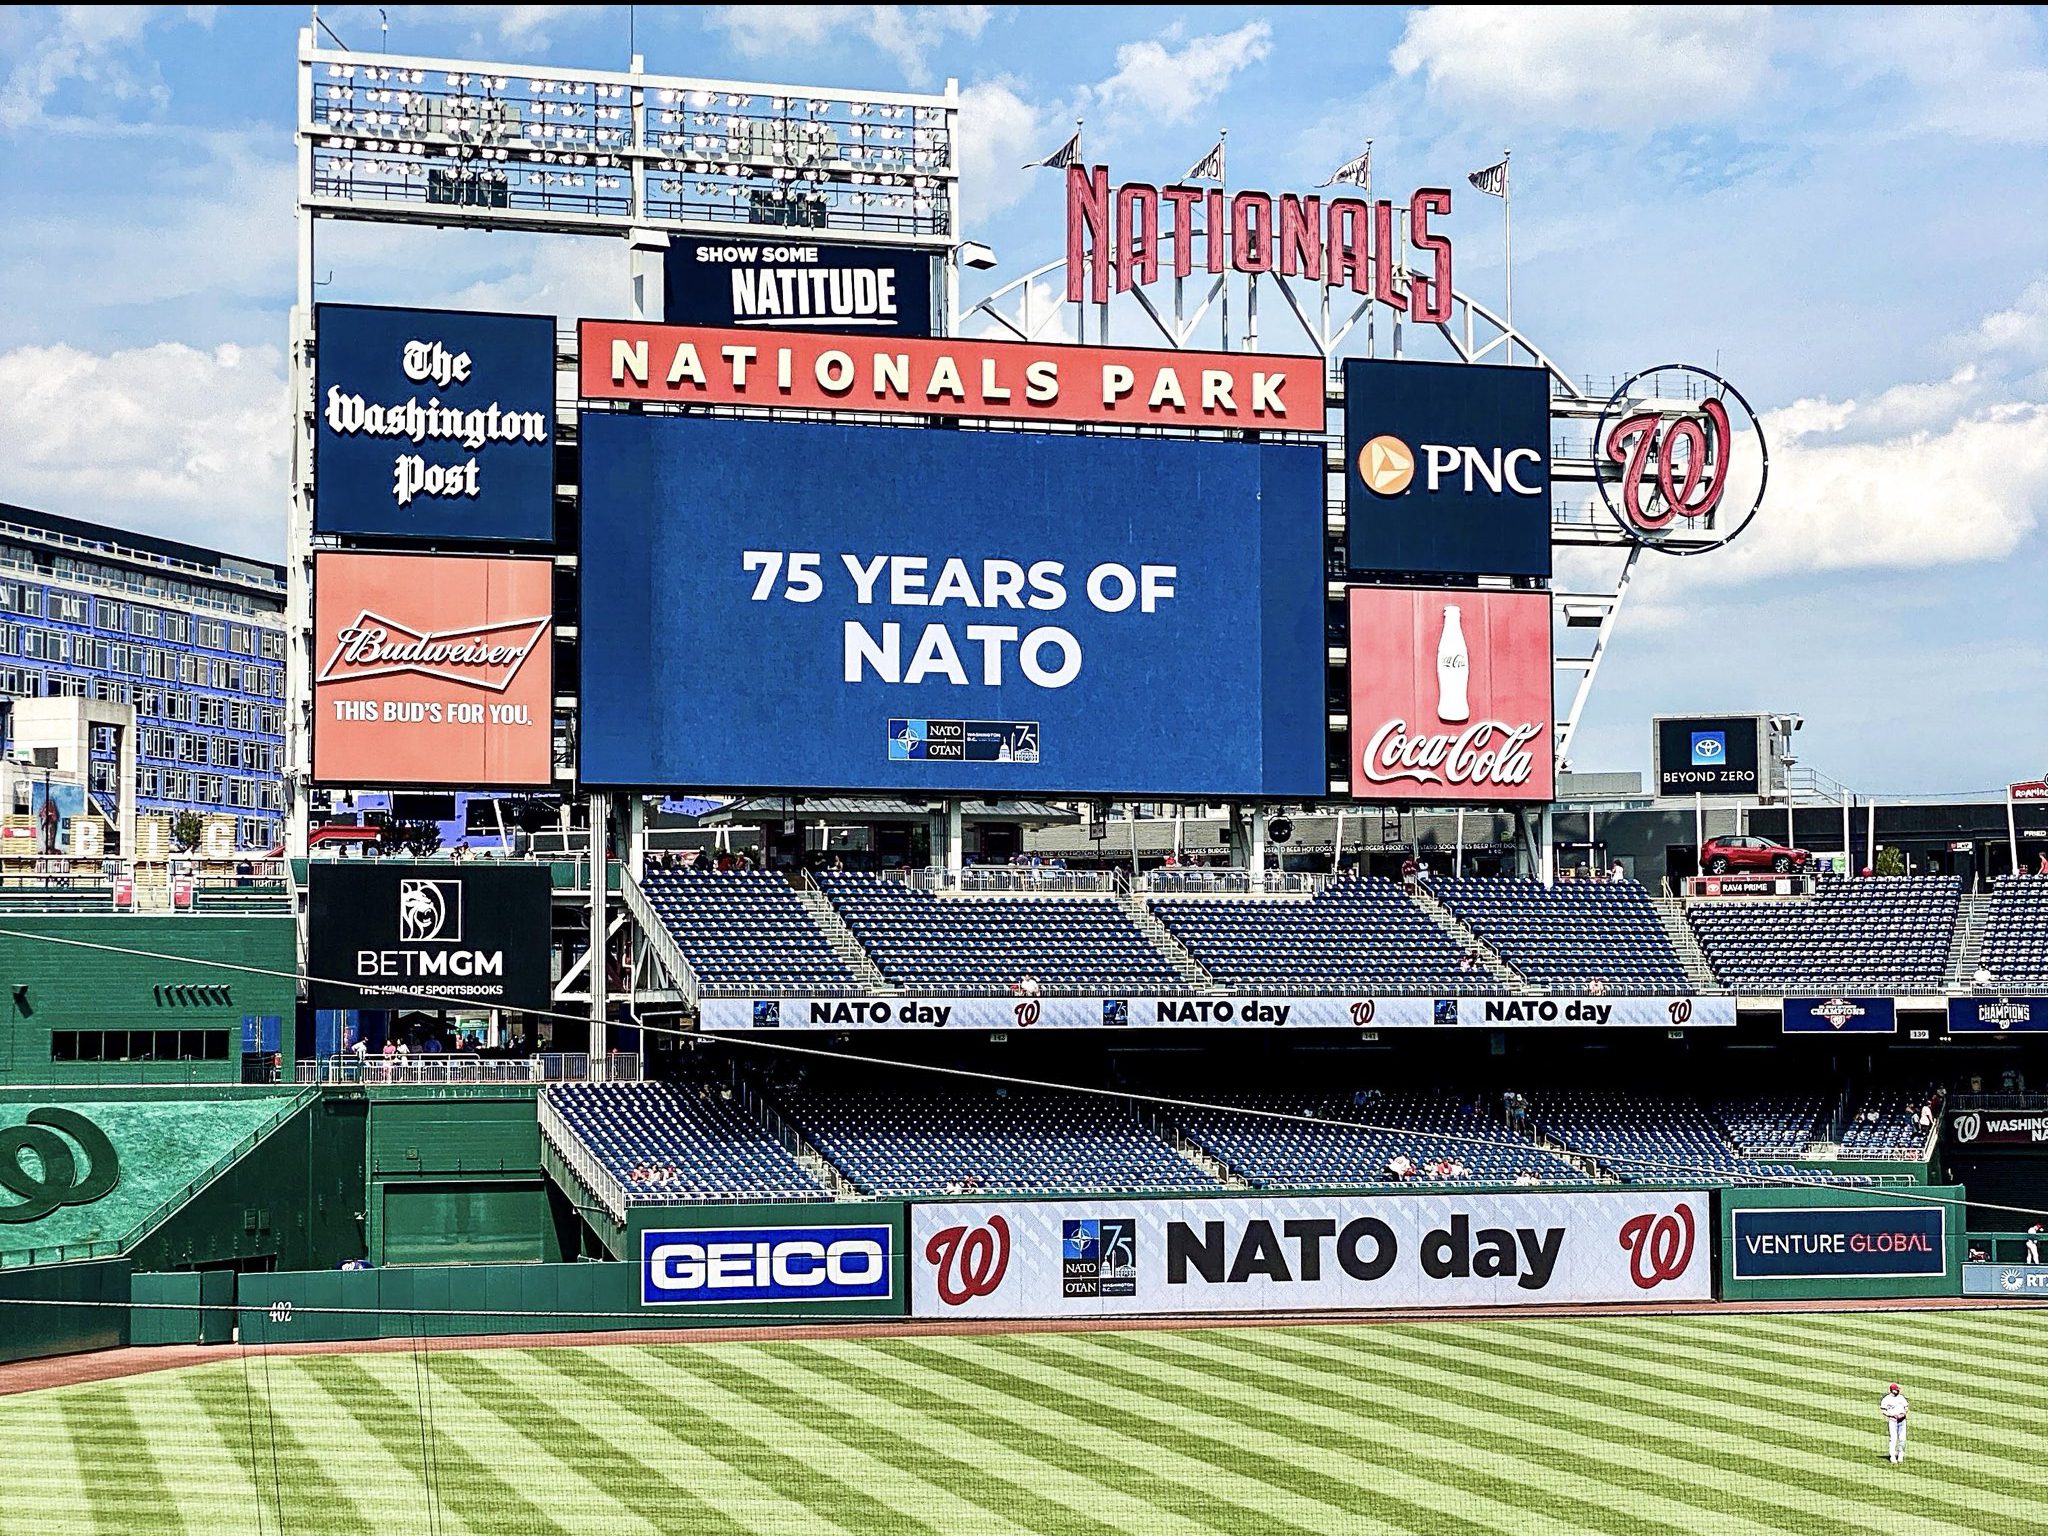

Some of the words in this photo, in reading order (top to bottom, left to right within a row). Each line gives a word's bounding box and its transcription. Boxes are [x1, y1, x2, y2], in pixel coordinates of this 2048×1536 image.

[696, 246, 758, 263] SHOW
[762, 246, 818, 263] SOME
[1067, 163, 1452, 324] NATIONALS
[732, 268, 897, 316] NATITUDE
[403, 341, 471, 386] The
[611, 339, 1058, 402] NATIONALS
[1103, 365, 1288, 412] PARK
[325, 385, 547, 449] Washington
[393, 454, 480, 505] Post
[1421, 445, 1542, 495] PNC
[743, 550, 823, 603] 75
[841, 554, 1067, 611] YEARS
[1087, 562, 1177, 613] OF
[338, 627, 526, 665] Budweiser
[844, 621, 1082, 689] NATO
[333, 700, 378, 721] THIS
[383, 701, 442, 723] BUD'S
[447, 703, 484, 724] FOR
[489, 704, 533, 726] YOU.
[929, 725, 961, 737] NATO
[1015, 725, 1037, 751] 75
[929, 744, 961, 756] OTAN
[1363, 719, 1544, 786] Coca-Cola
[1663, 771, 1716, 783] BEYOND
[1720, 770, 1755, 782] ZERO
[1722, 883, 1742, 892] RAV4
[1743, 883, 1768, 892] PRIME
[357, 951, 503, 976] BETMGM
[409, 985, 425, 995] OF
[425, 985, 503, 995] SPORTSBOOKS
[811, 1002, 892, 1024] NATO
[899, 1001, 951, 1028] day
[1157, 1001, 1234, 1023] NATO
[1241, 1000, 1291, 1027] day
[1485, 1000, 1558, 1022] NATO
[1565, 999, 1612, 1025] day
[1810, 1007, 1866, 1016] CHAMPIONS
[1979, 1005, 2030, 1021] CHAMPIONS
[1102, 1225, 1133, 1266] 75
[1166, 1216, 1398, 1285] NATO
[1419, 1213, 1567, 1290] day
[1745, 1233, 1845, 1254] VENTURE
[1850, 1232, 1932, 1252] GLOBAL
[650, 1240, 883, 1290] GEICO
[1065, 1263, 1097, 1274] NATO
[1065, 1282, 1097, 1293] OTAN
[2026, 1273, 2048, 1287] RT
[268, 1301, 292, 1322] 402
